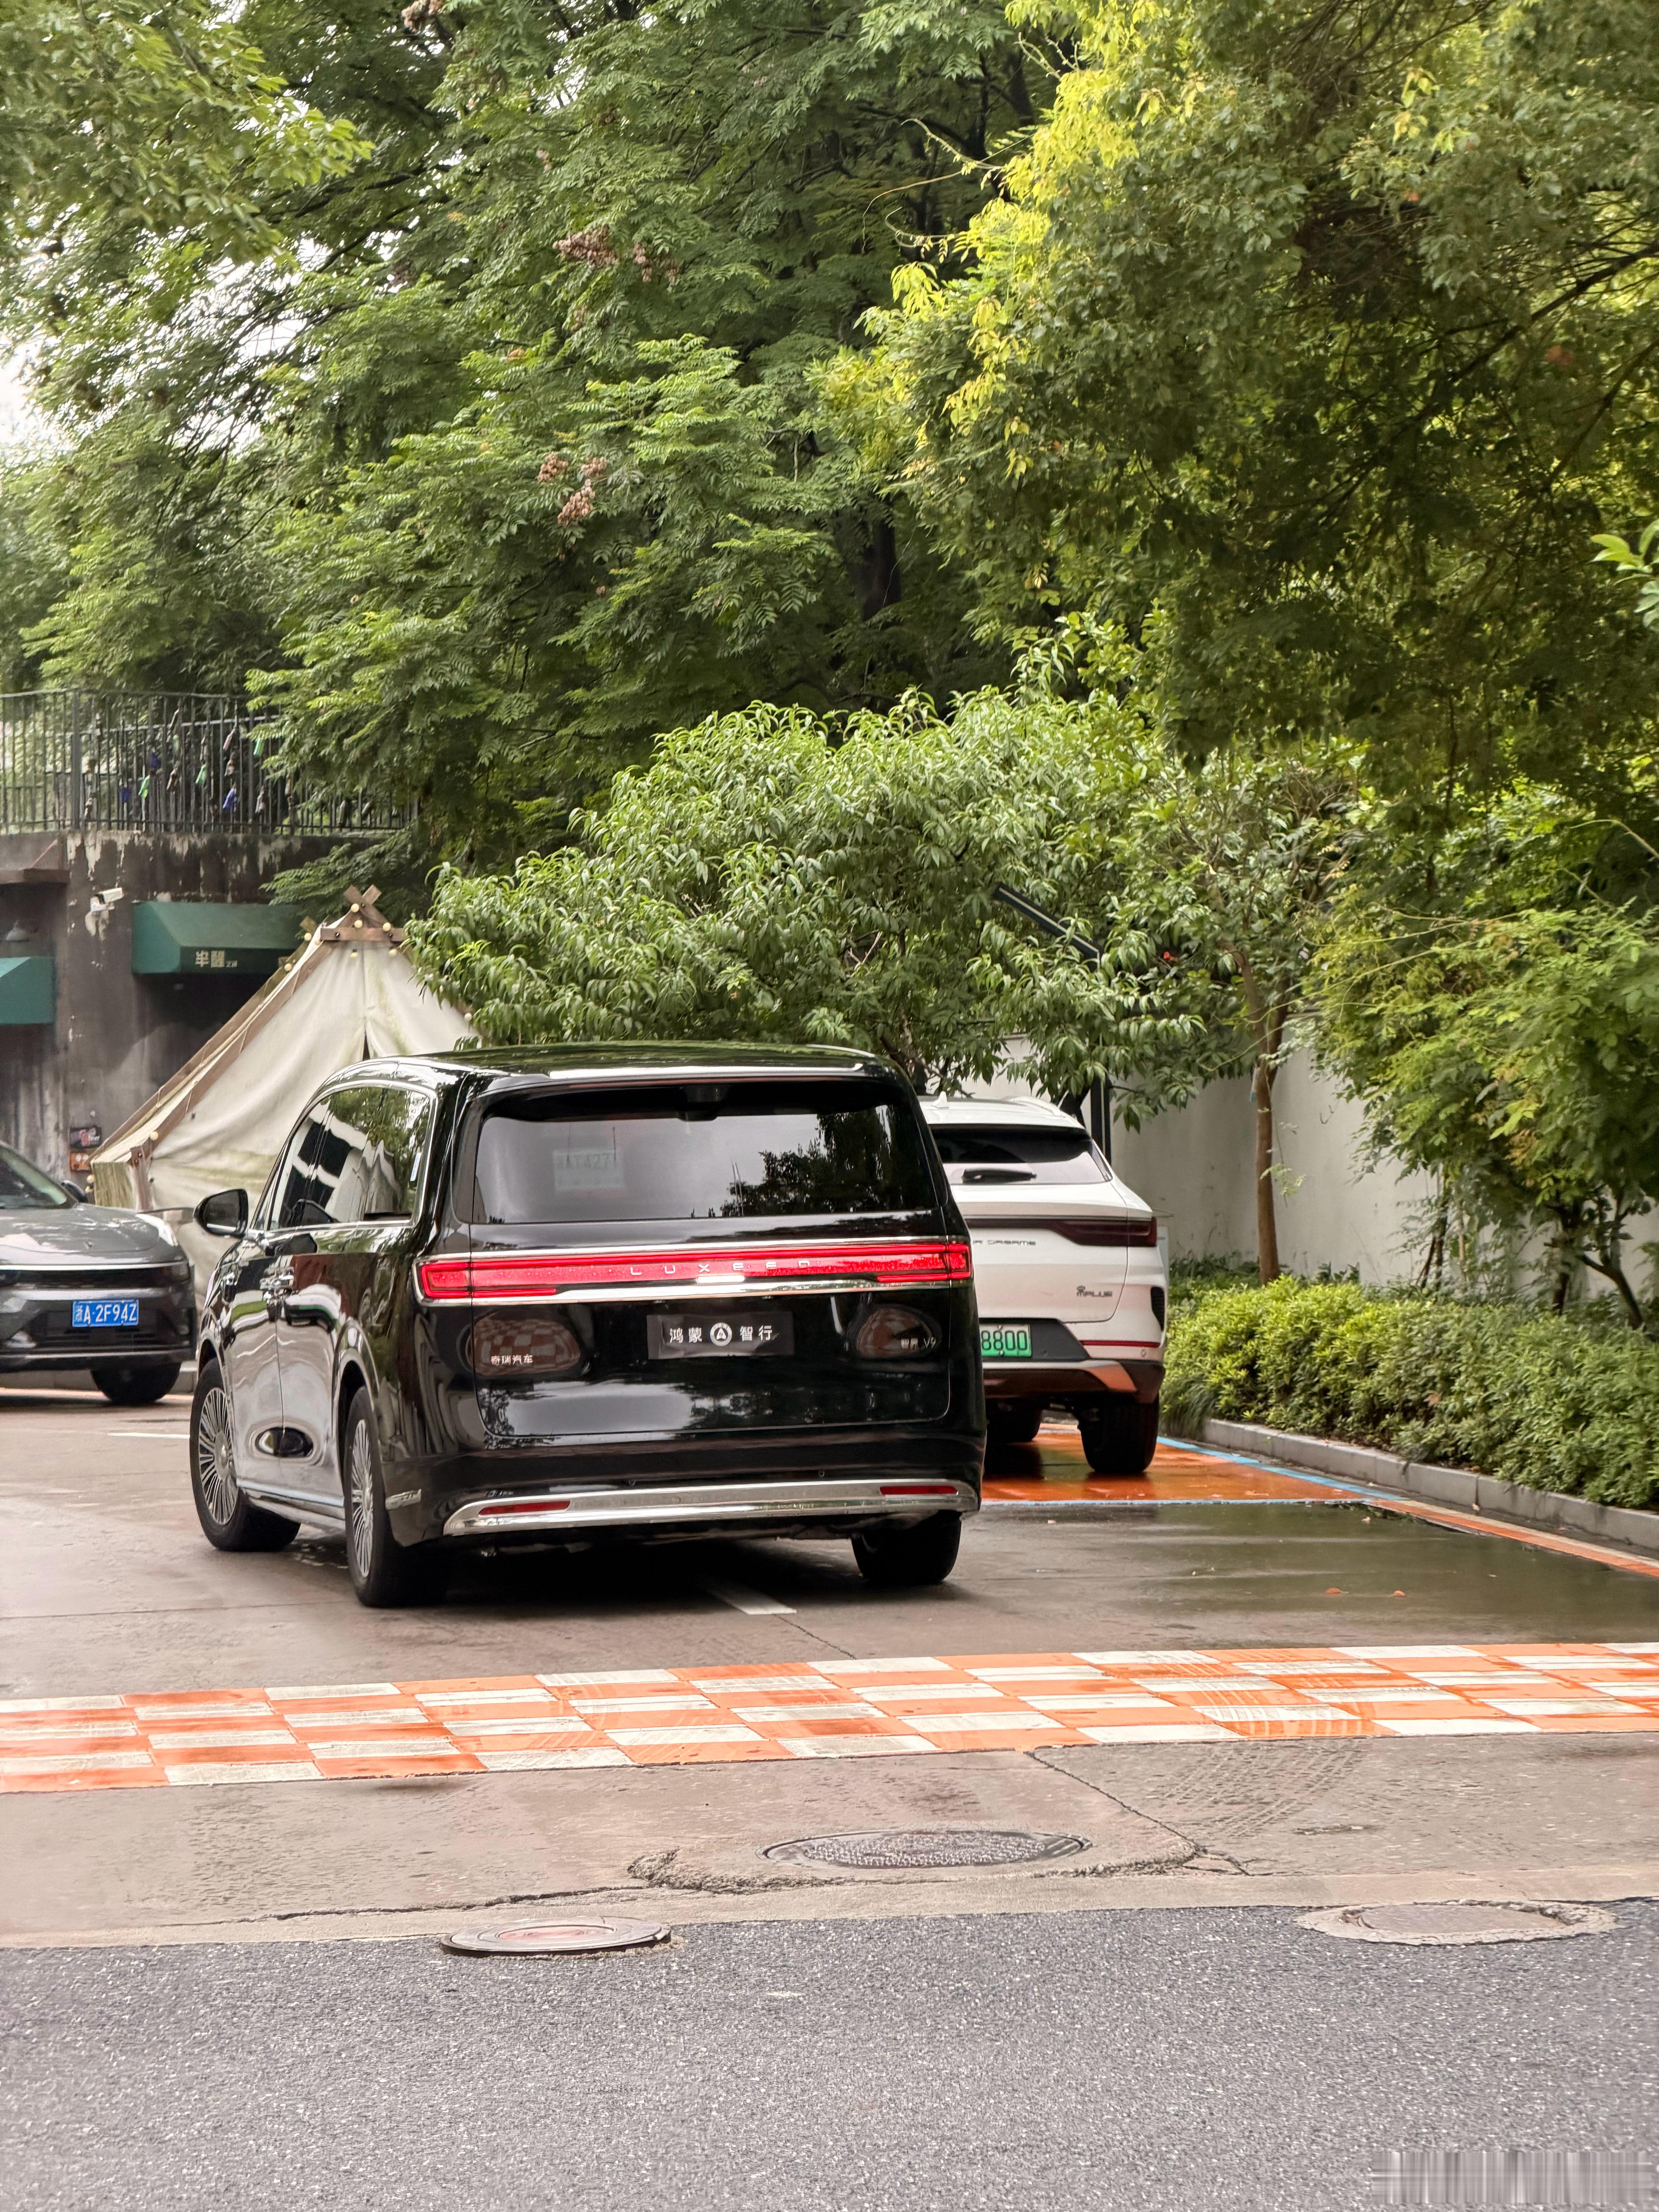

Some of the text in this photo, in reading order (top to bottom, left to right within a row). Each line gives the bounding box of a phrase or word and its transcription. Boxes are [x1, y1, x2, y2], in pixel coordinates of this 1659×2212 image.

[669, 1325, 773, 1343] 鸿蒙 智行
[981, 1330, 1027, 1351] 8800
[491, 1354, 533, 1366] 奇瑞汽车
